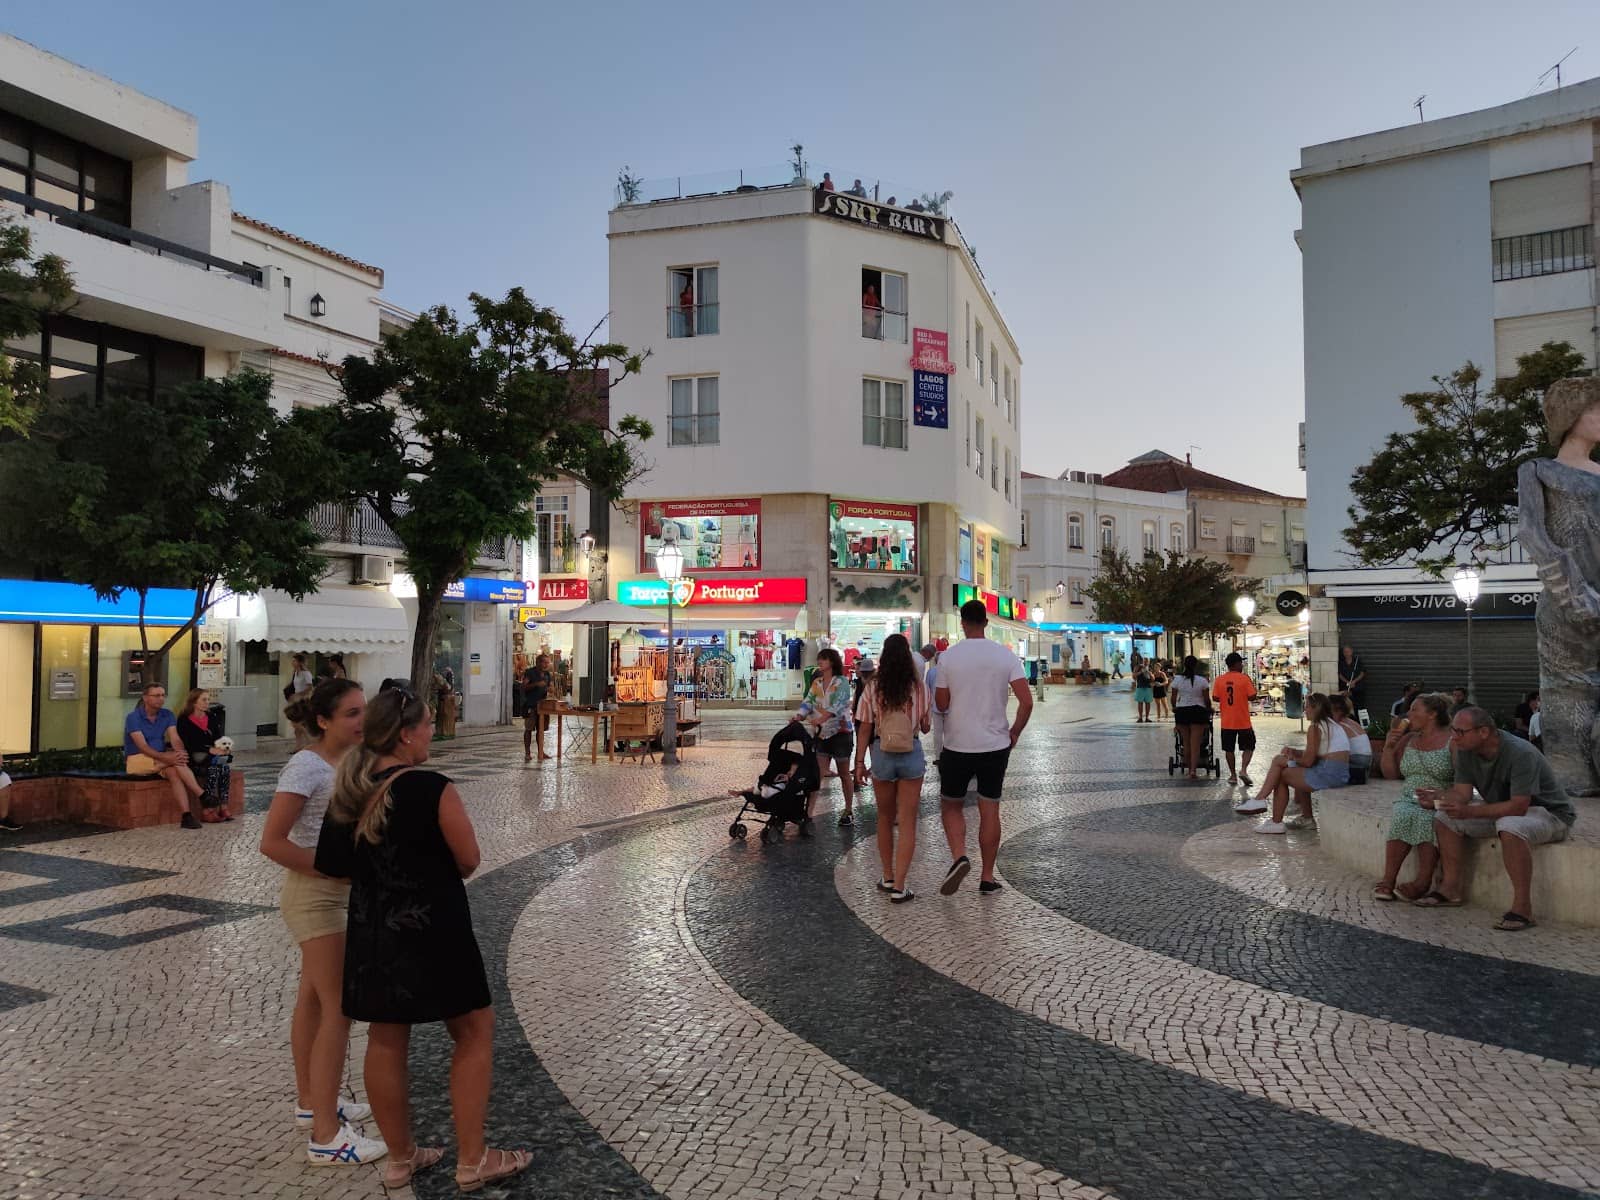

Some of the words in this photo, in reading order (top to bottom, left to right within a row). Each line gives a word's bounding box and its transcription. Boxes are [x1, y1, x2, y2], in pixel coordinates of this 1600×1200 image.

[835, 197, 880, 224] SKY
[888, 212, 926, 235] BAR
[919, 374, 944, 384] LAGOS
[919, 382, 944, 393] CENTER
[919, 391, 945, 401] STUDIOS
[847, 506, 873, 515] FORÇA
[873, 508, 913, 518] PORTUGAL
[543, 583, 569, 598] ALL
[701, 584, 760, 602] Portugal
[1410, 594, 1457, 609] Silva
[523, 609, 542, 617] ATM
[1226, 686, 1234, 706] 3
